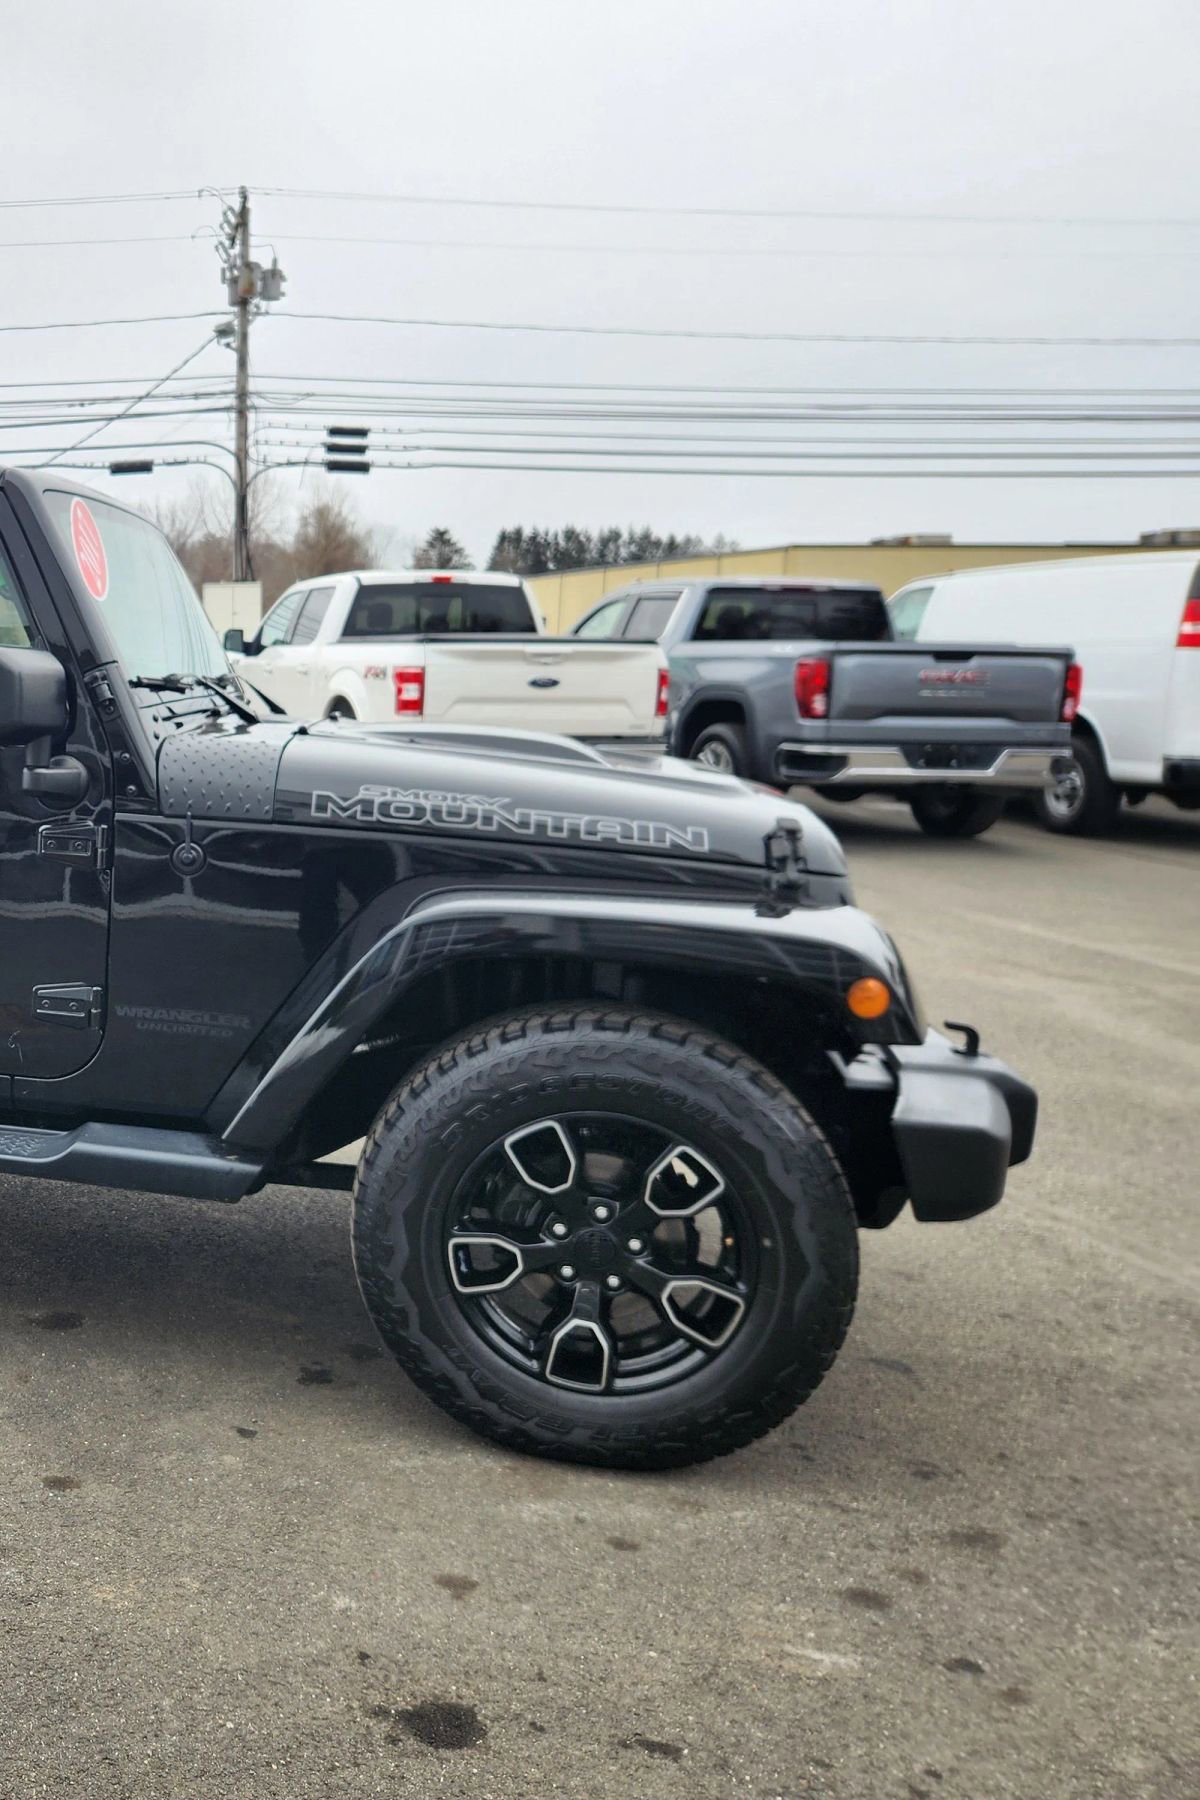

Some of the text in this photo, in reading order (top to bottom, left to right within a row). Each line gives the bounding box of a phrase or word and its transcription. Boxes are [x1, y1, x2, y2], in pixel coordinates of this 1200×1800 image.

[359, 784, 512, 807] SMOKY
[311, 790, 709, 852] MOUNTAIN
[114, 1005, 251, 1029] WRANGLER
[136, 1022, 233, 1037] UNLIMITED
